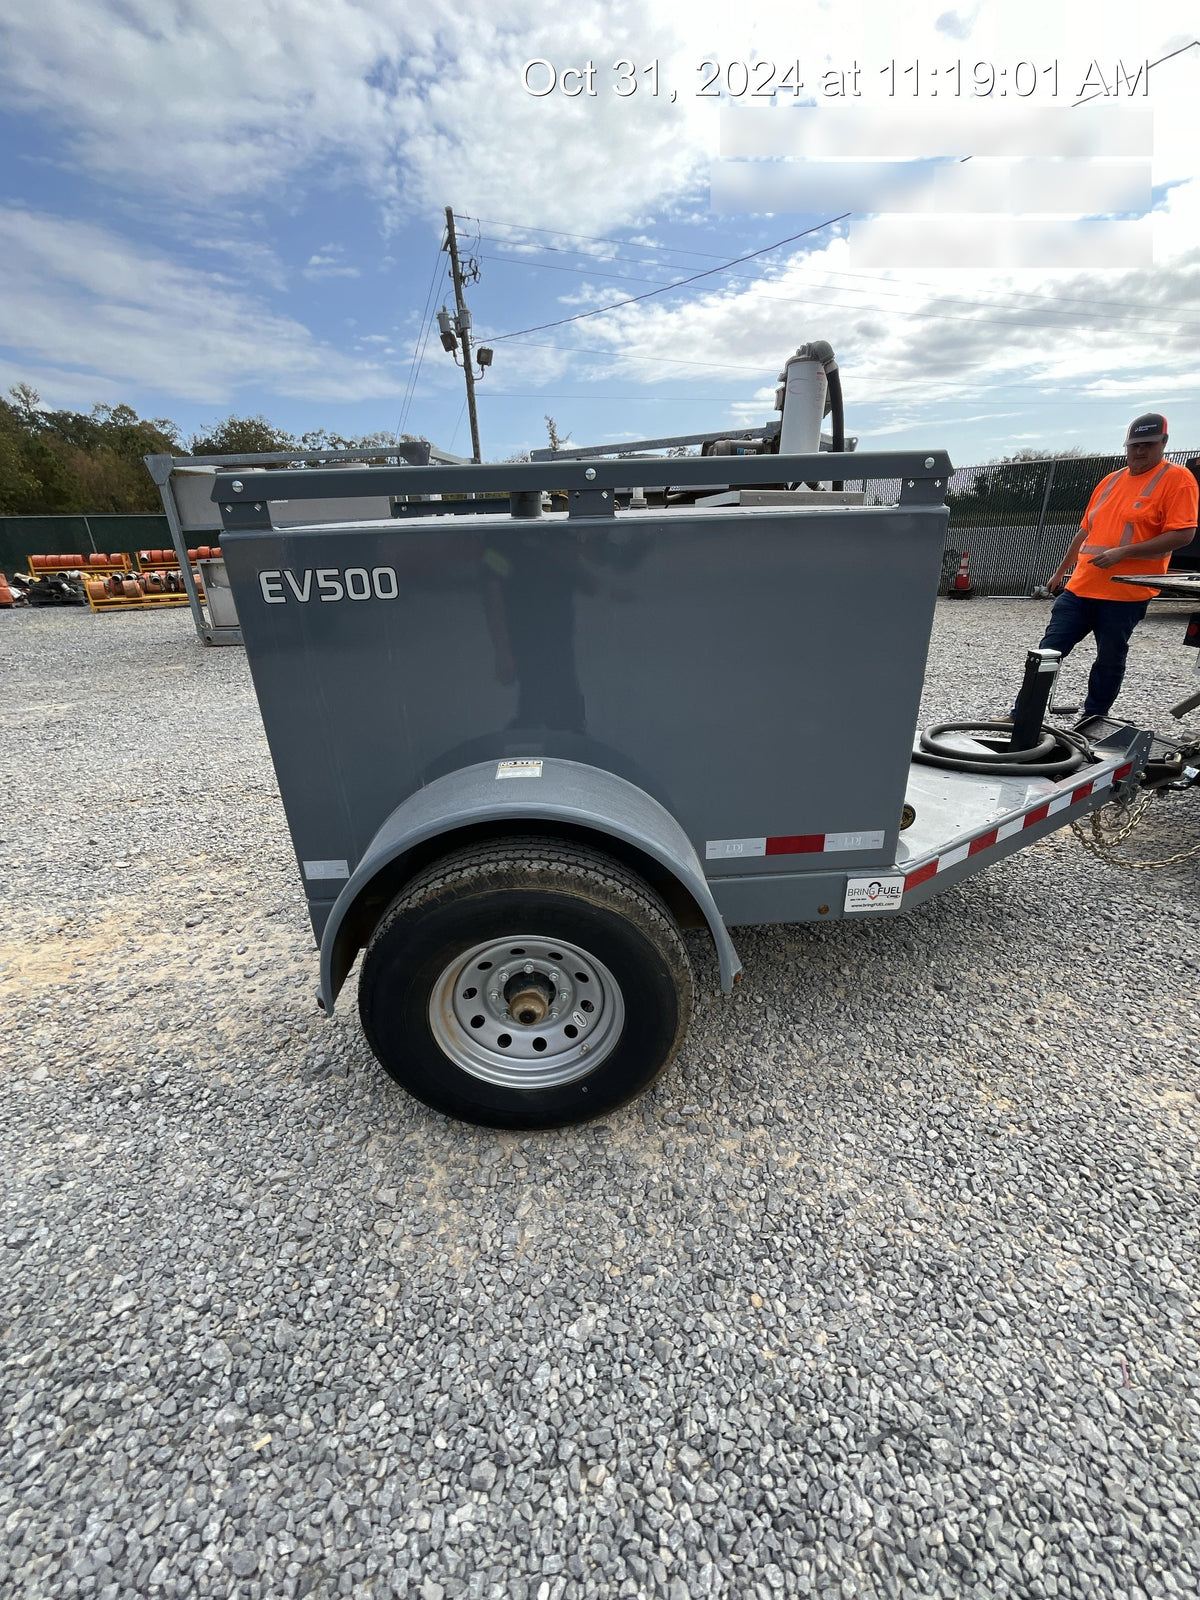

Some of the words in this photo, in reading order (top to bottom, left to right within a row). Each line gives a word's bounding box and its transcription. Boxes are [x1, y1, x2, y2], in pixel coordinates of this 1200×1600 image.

[258, 566, 399, 604] EV500
[847, 887, 876, 897] BRING
[877, 886, 902, 895] FUEL
